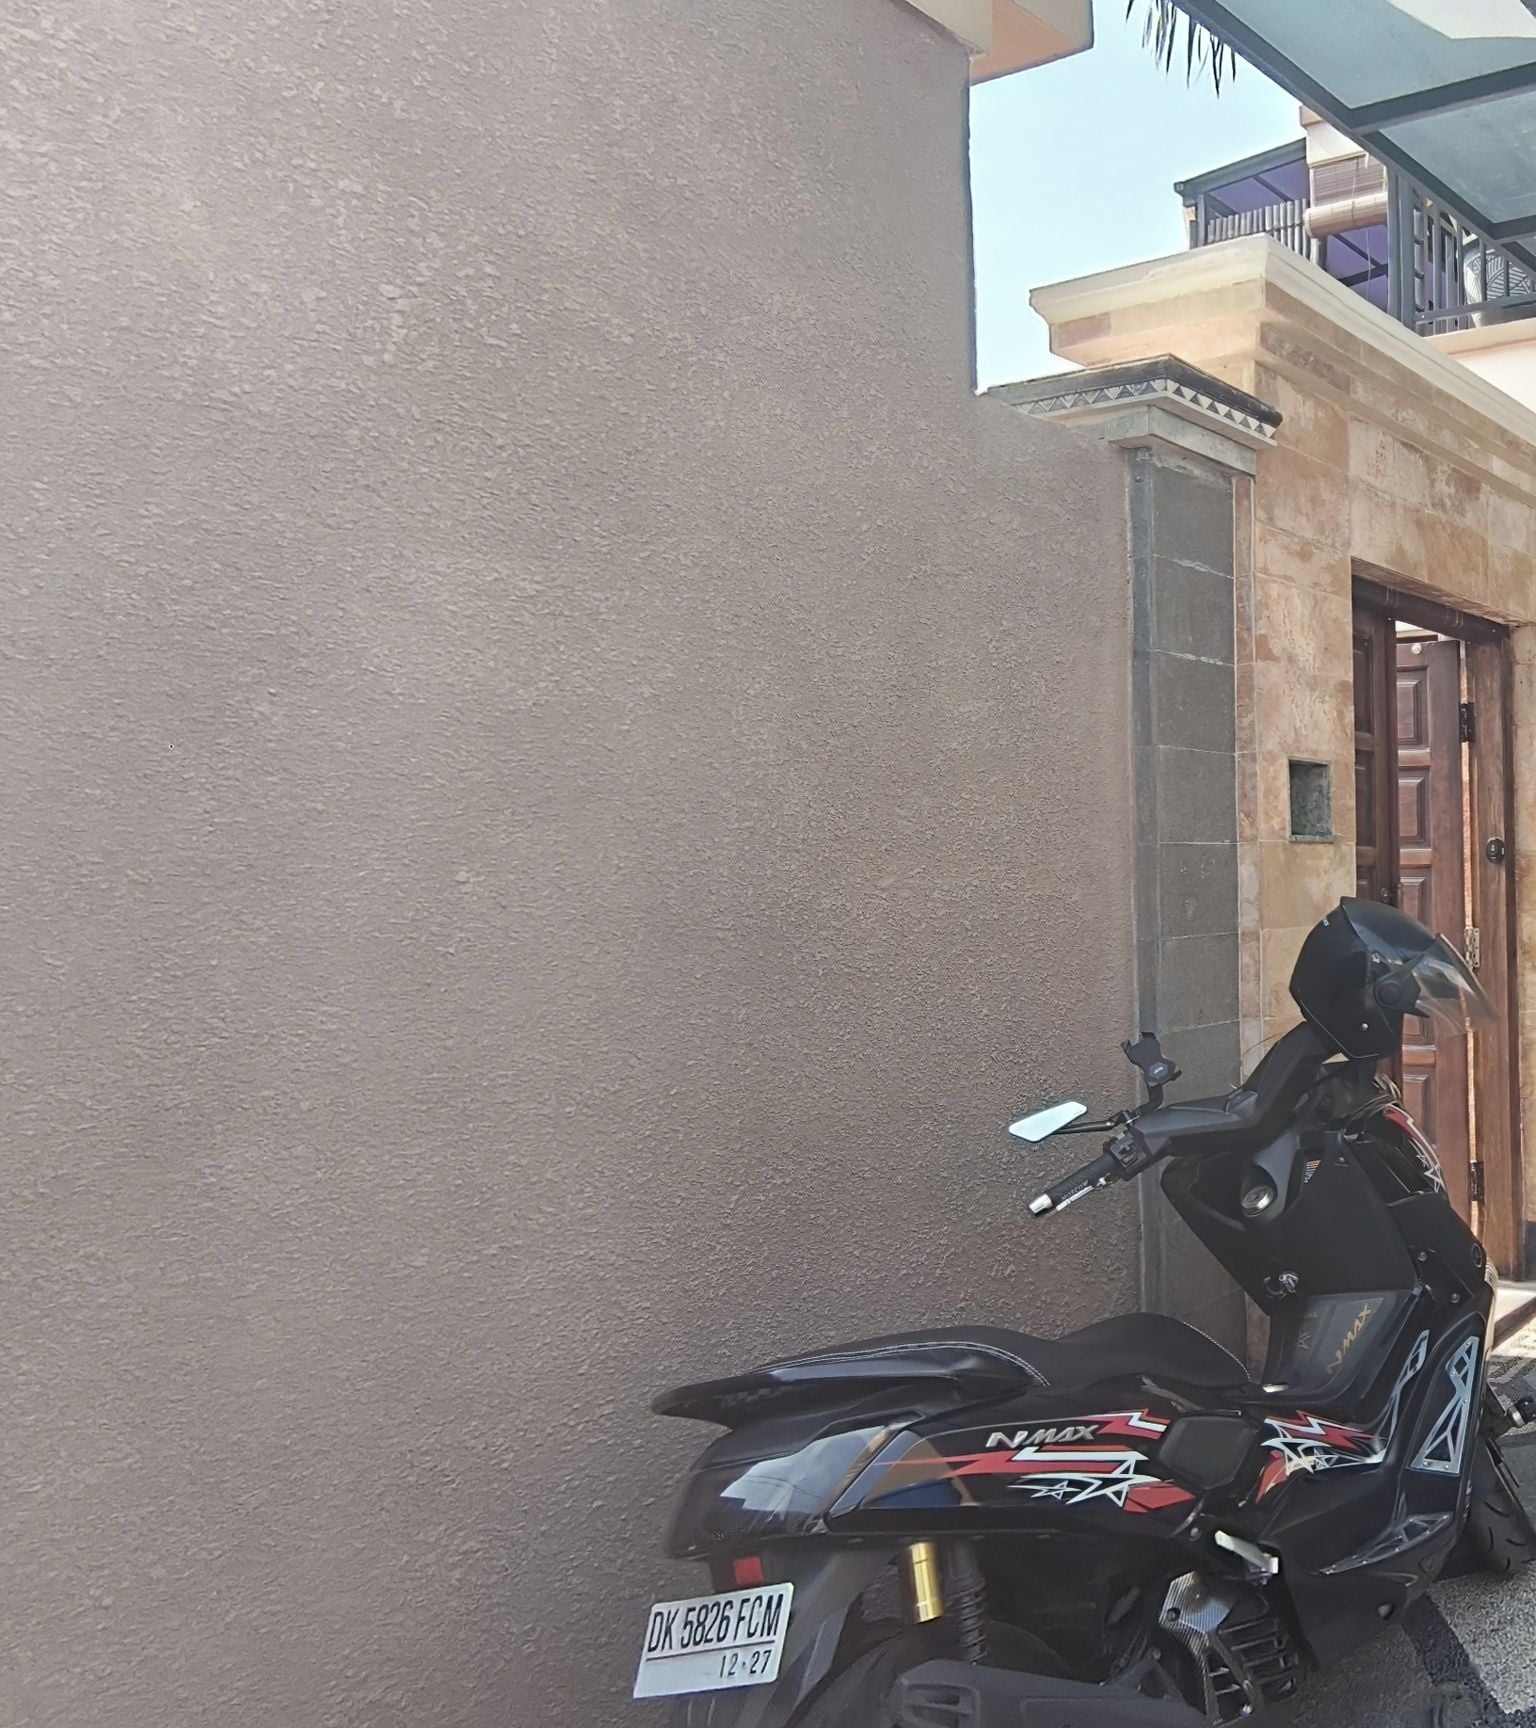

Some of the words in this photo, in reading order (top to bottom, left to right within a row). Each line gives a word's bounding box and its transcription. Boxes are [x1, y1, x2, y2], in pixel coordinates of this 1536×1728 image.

[985, 1424, 1100, 1449] NMAX
[648, 1607, 680, 1653] DK
[680, 1600, 734, 1649] 5826
[734, 1594, 784, 1642] FCM
